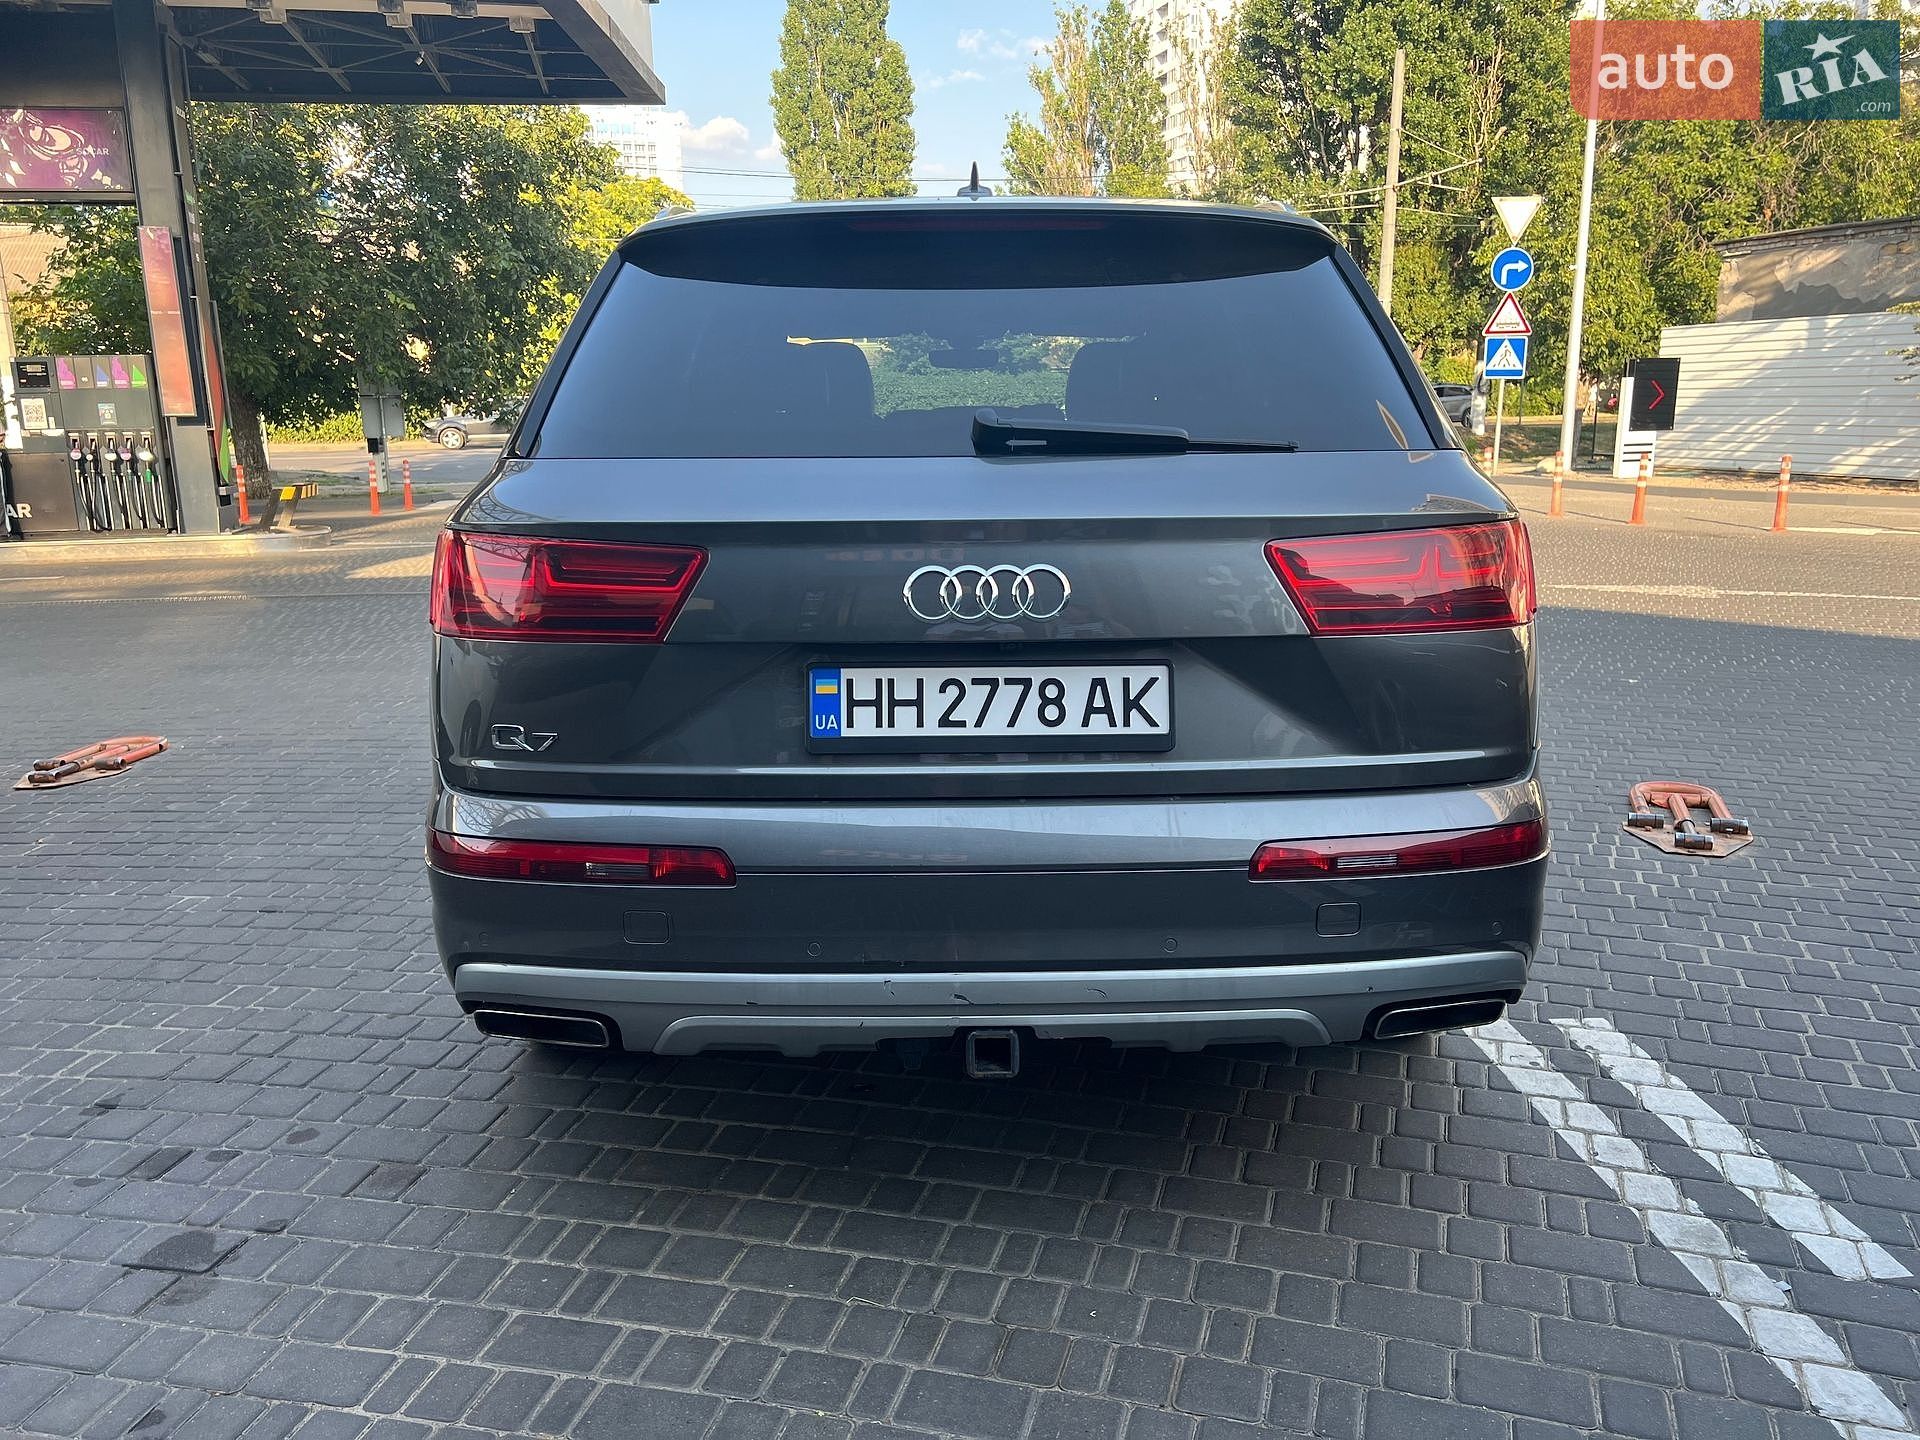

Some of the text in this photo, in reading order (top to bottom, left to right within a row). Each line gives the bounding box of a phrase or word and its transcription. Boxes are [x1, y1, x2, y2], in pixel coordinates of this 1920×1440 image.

[845, 676, 1161, 729] HH 2778 AK
[491, 723, 559, 752] Q7
[815, 715, 839, 731] UA
